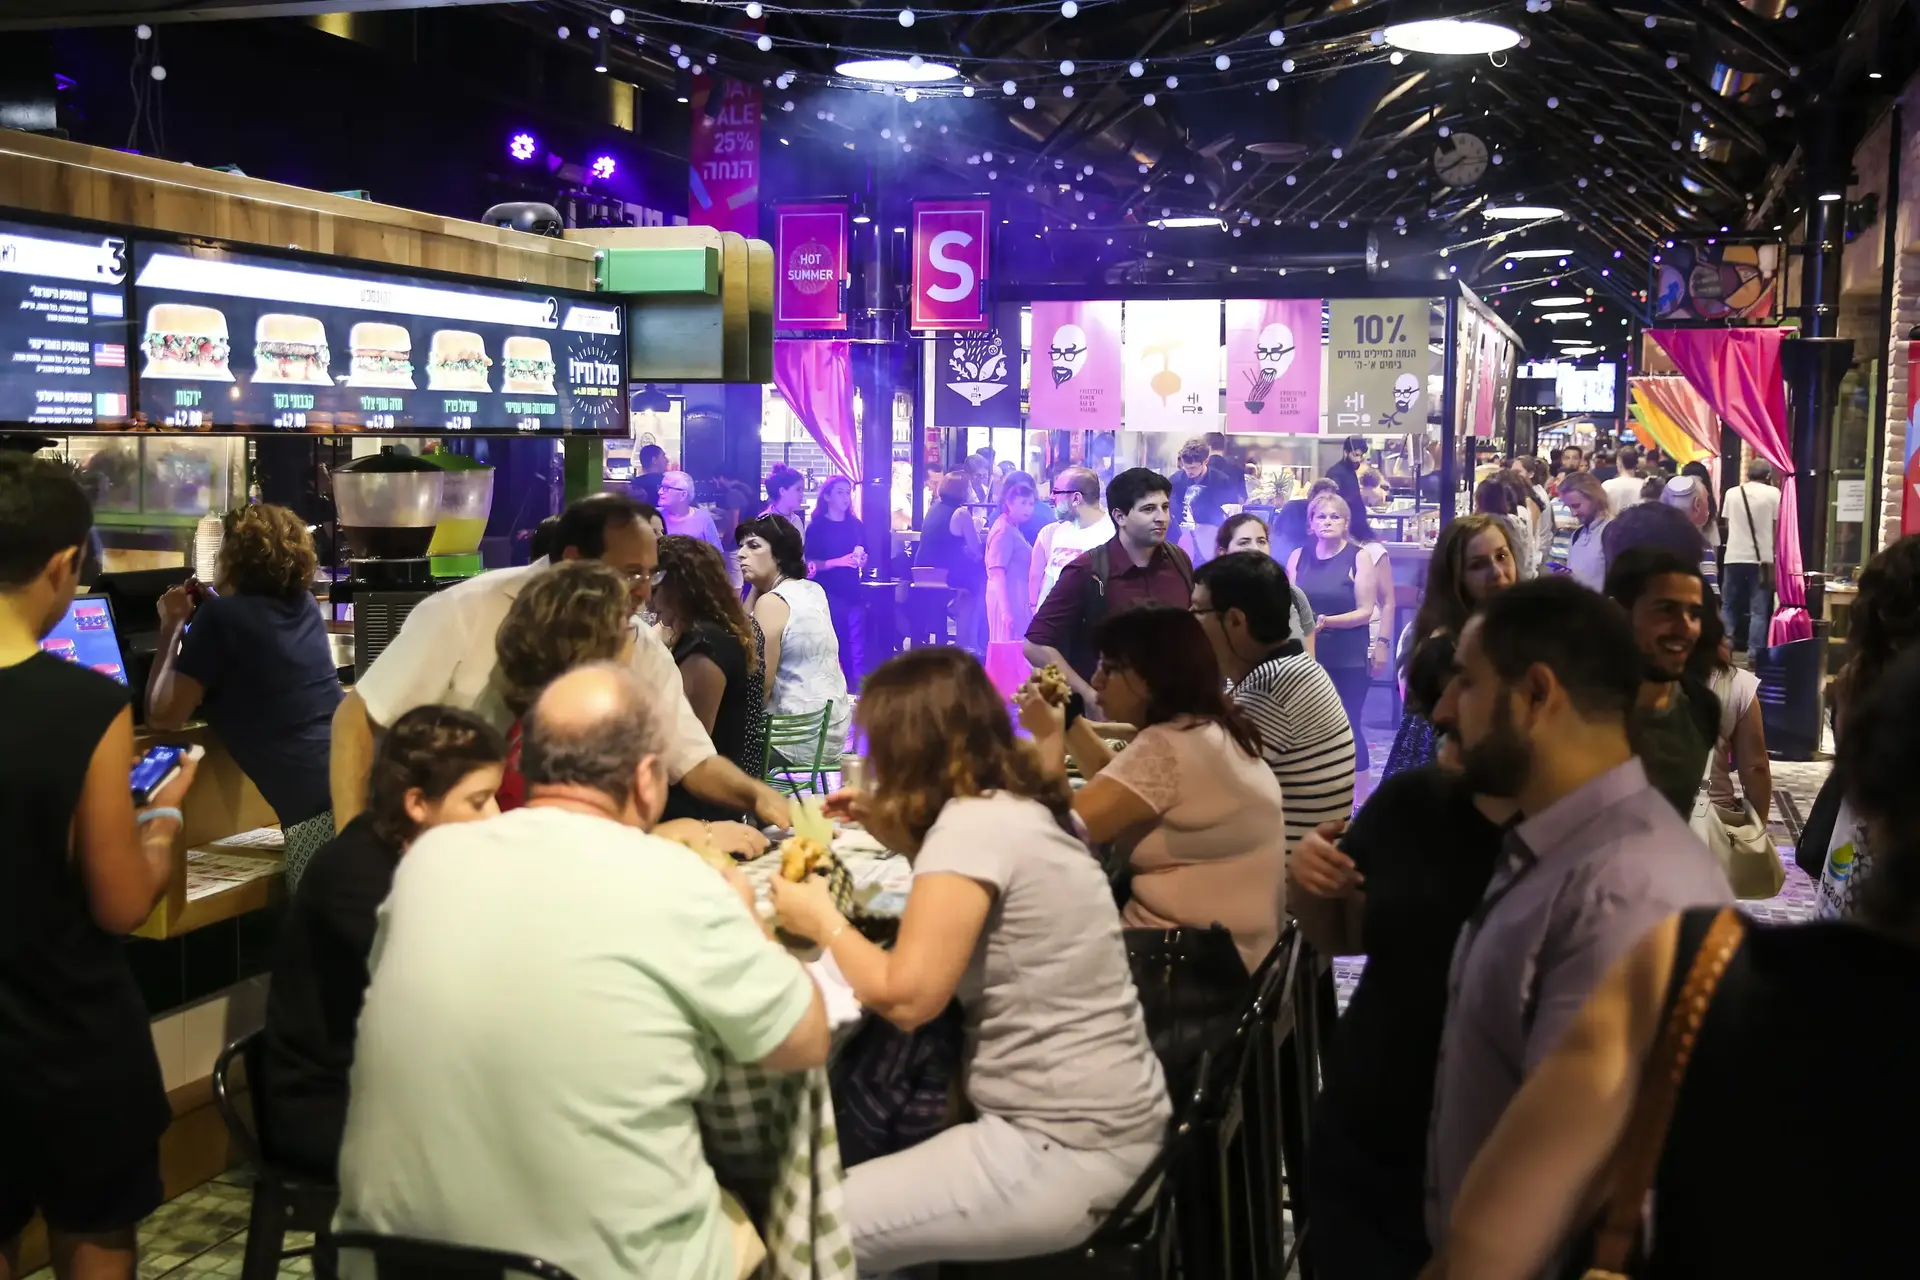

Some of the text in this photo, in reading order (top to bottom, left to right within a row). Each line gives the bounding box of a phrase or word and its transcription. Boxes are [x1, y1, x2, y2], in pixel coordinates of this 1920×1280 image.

[704, 103, 755, 126] ALE
[714, 131, 753, 153] 25%
[703, 160, 753, 180] הנחה
[799, 253, 821, 265] HOT
[926, 230, 975, 302] S
[787, 269, 834, 281] SUMMER
[1353, 314, 1407, 344] 10%
[1337, 349, 1416, 359] הנחה לחיילים במדים
[1379, 360, 1402, 369] בימים
